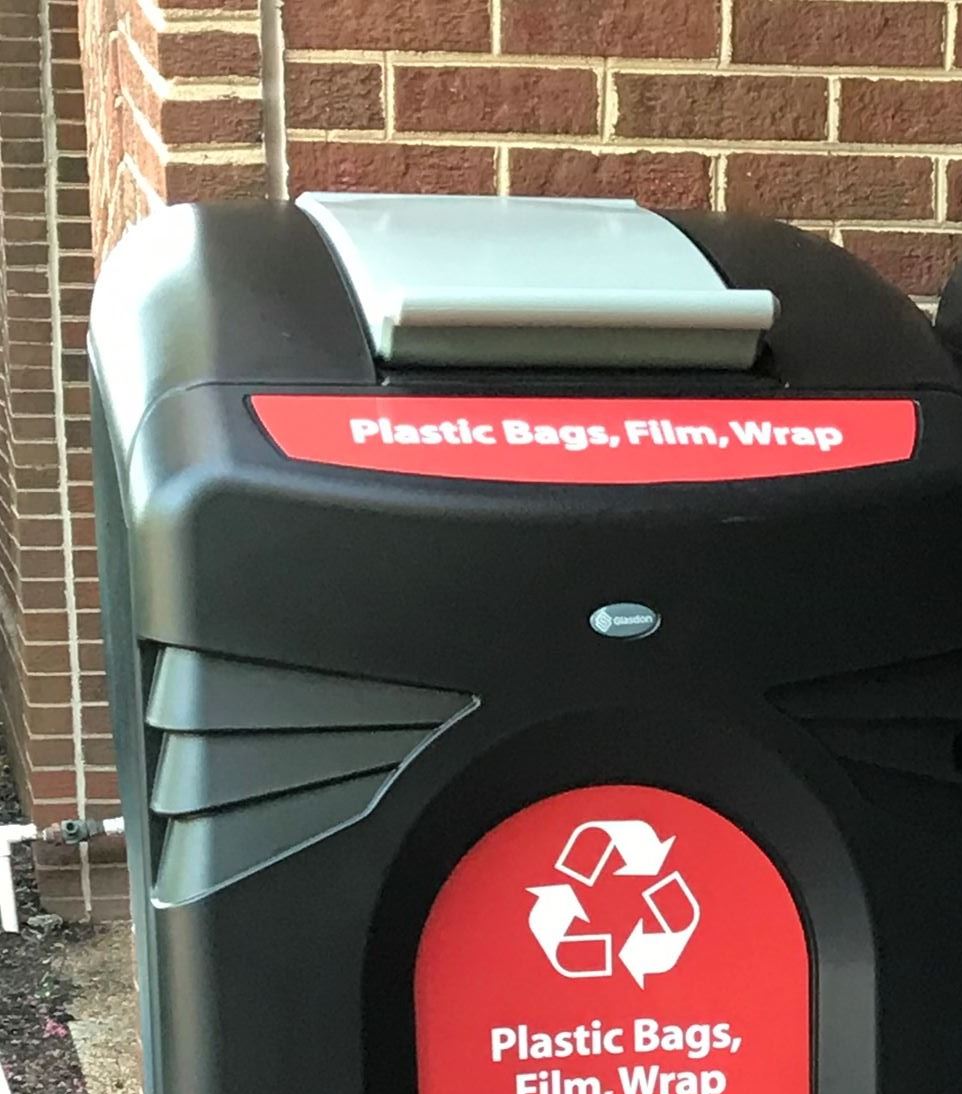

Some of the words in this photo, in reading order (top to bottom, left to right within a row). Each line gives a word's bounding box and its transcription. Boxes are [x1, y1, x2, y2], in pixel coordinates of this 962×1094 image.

[350, 417, 497, 445] Plastic
[502, 419, 621, 452] Bags,
[624, 418, 729, 449] Film,
[729, 420, 844, 452] Wrap
[490, 1019, 625, 1062] Plastic
[633, 1017, 742, 1059] Bags,
